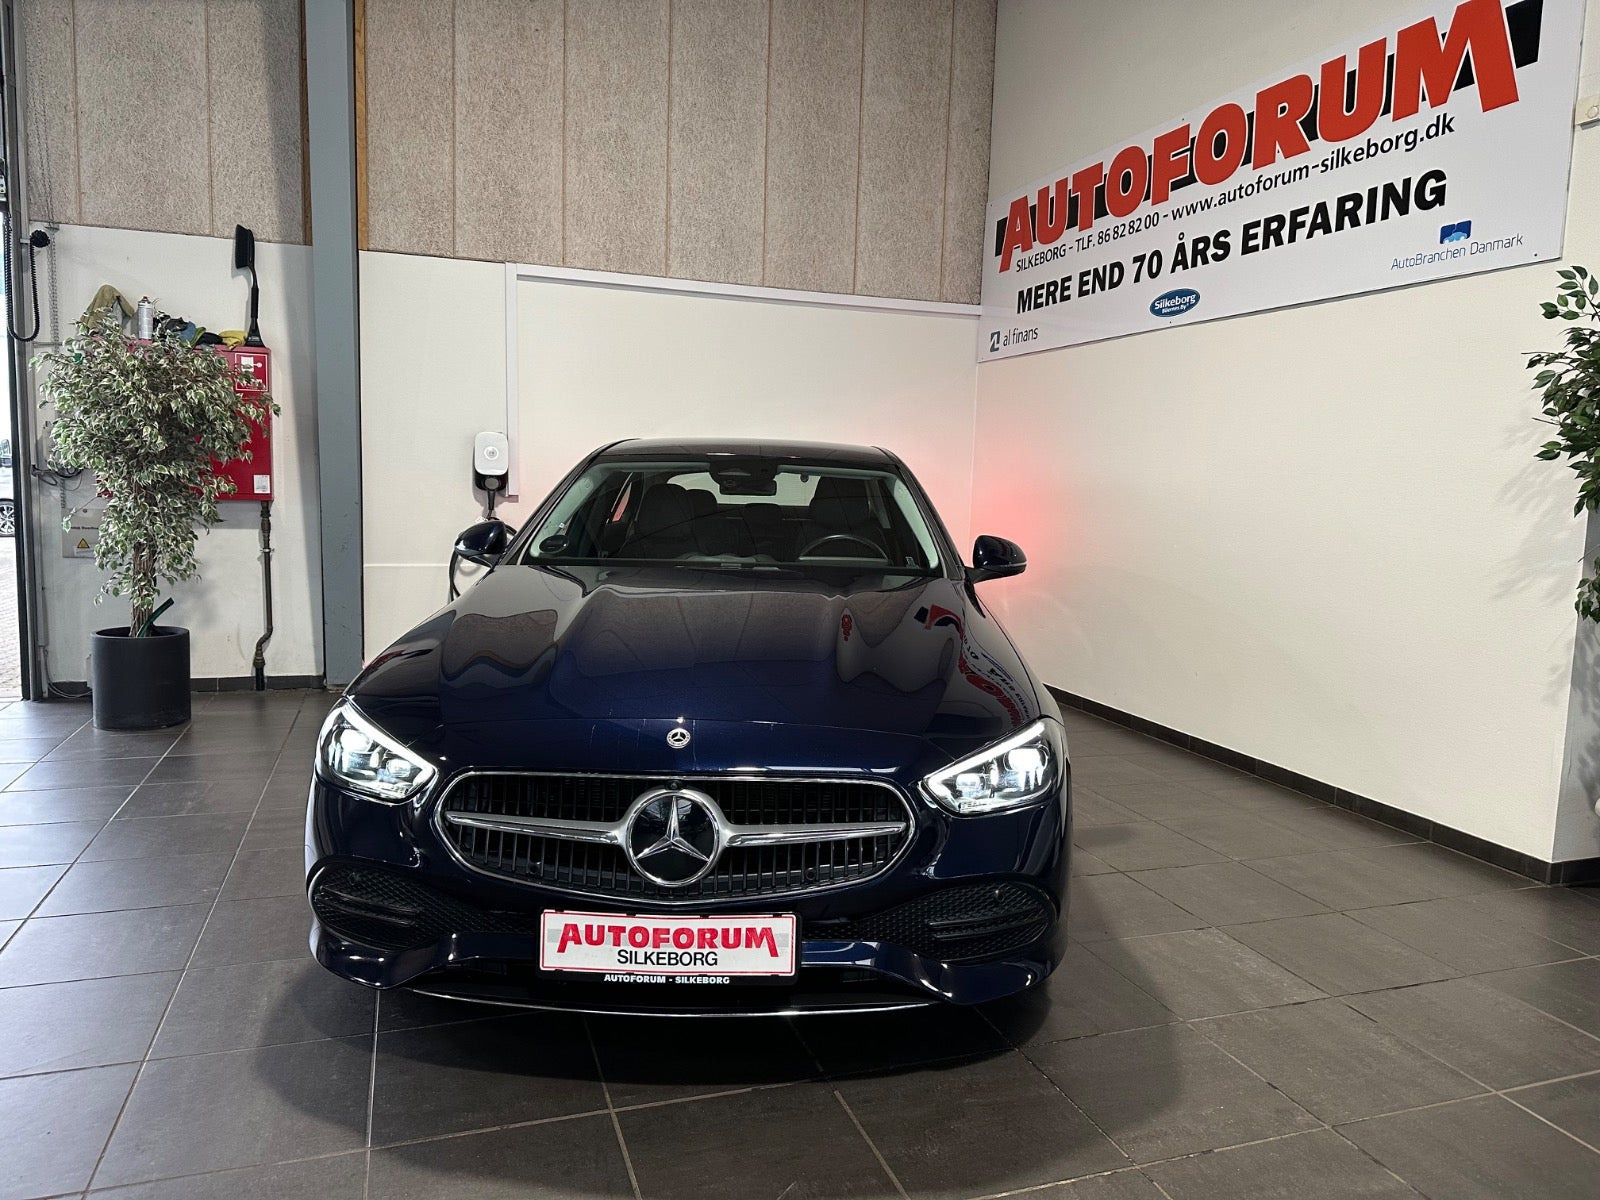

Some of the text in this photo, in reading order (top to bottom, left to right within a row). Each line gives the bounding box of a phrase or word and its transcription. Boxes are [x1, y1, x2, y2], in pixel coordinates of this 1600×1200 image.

[997, 0, 1520, 273] AUTOFORUM
[1016, 243, 1067, 273] SILKEBORG
[1075, 234, 1095, 253] TLF.
[1171, 112, 1456, 221] www.autoforum-silkeborg.dk
[1016, 169, 1448, 315] MERE END 70 ÅRS ERFARING
[1391, 233, 1524, 271] AutoBranchen Danmark
[1154, 294, 1196, 310] Silkeborg
[1003, 327, 1039, 347] al finans
[556, 923, 779, 958] AUTOFORUM
[617, 949, 718, 967] SILKEBORG
[604, 974, 666, 984] AUTOFORUM
[675, 976, 730, 985] SILKEBORG
